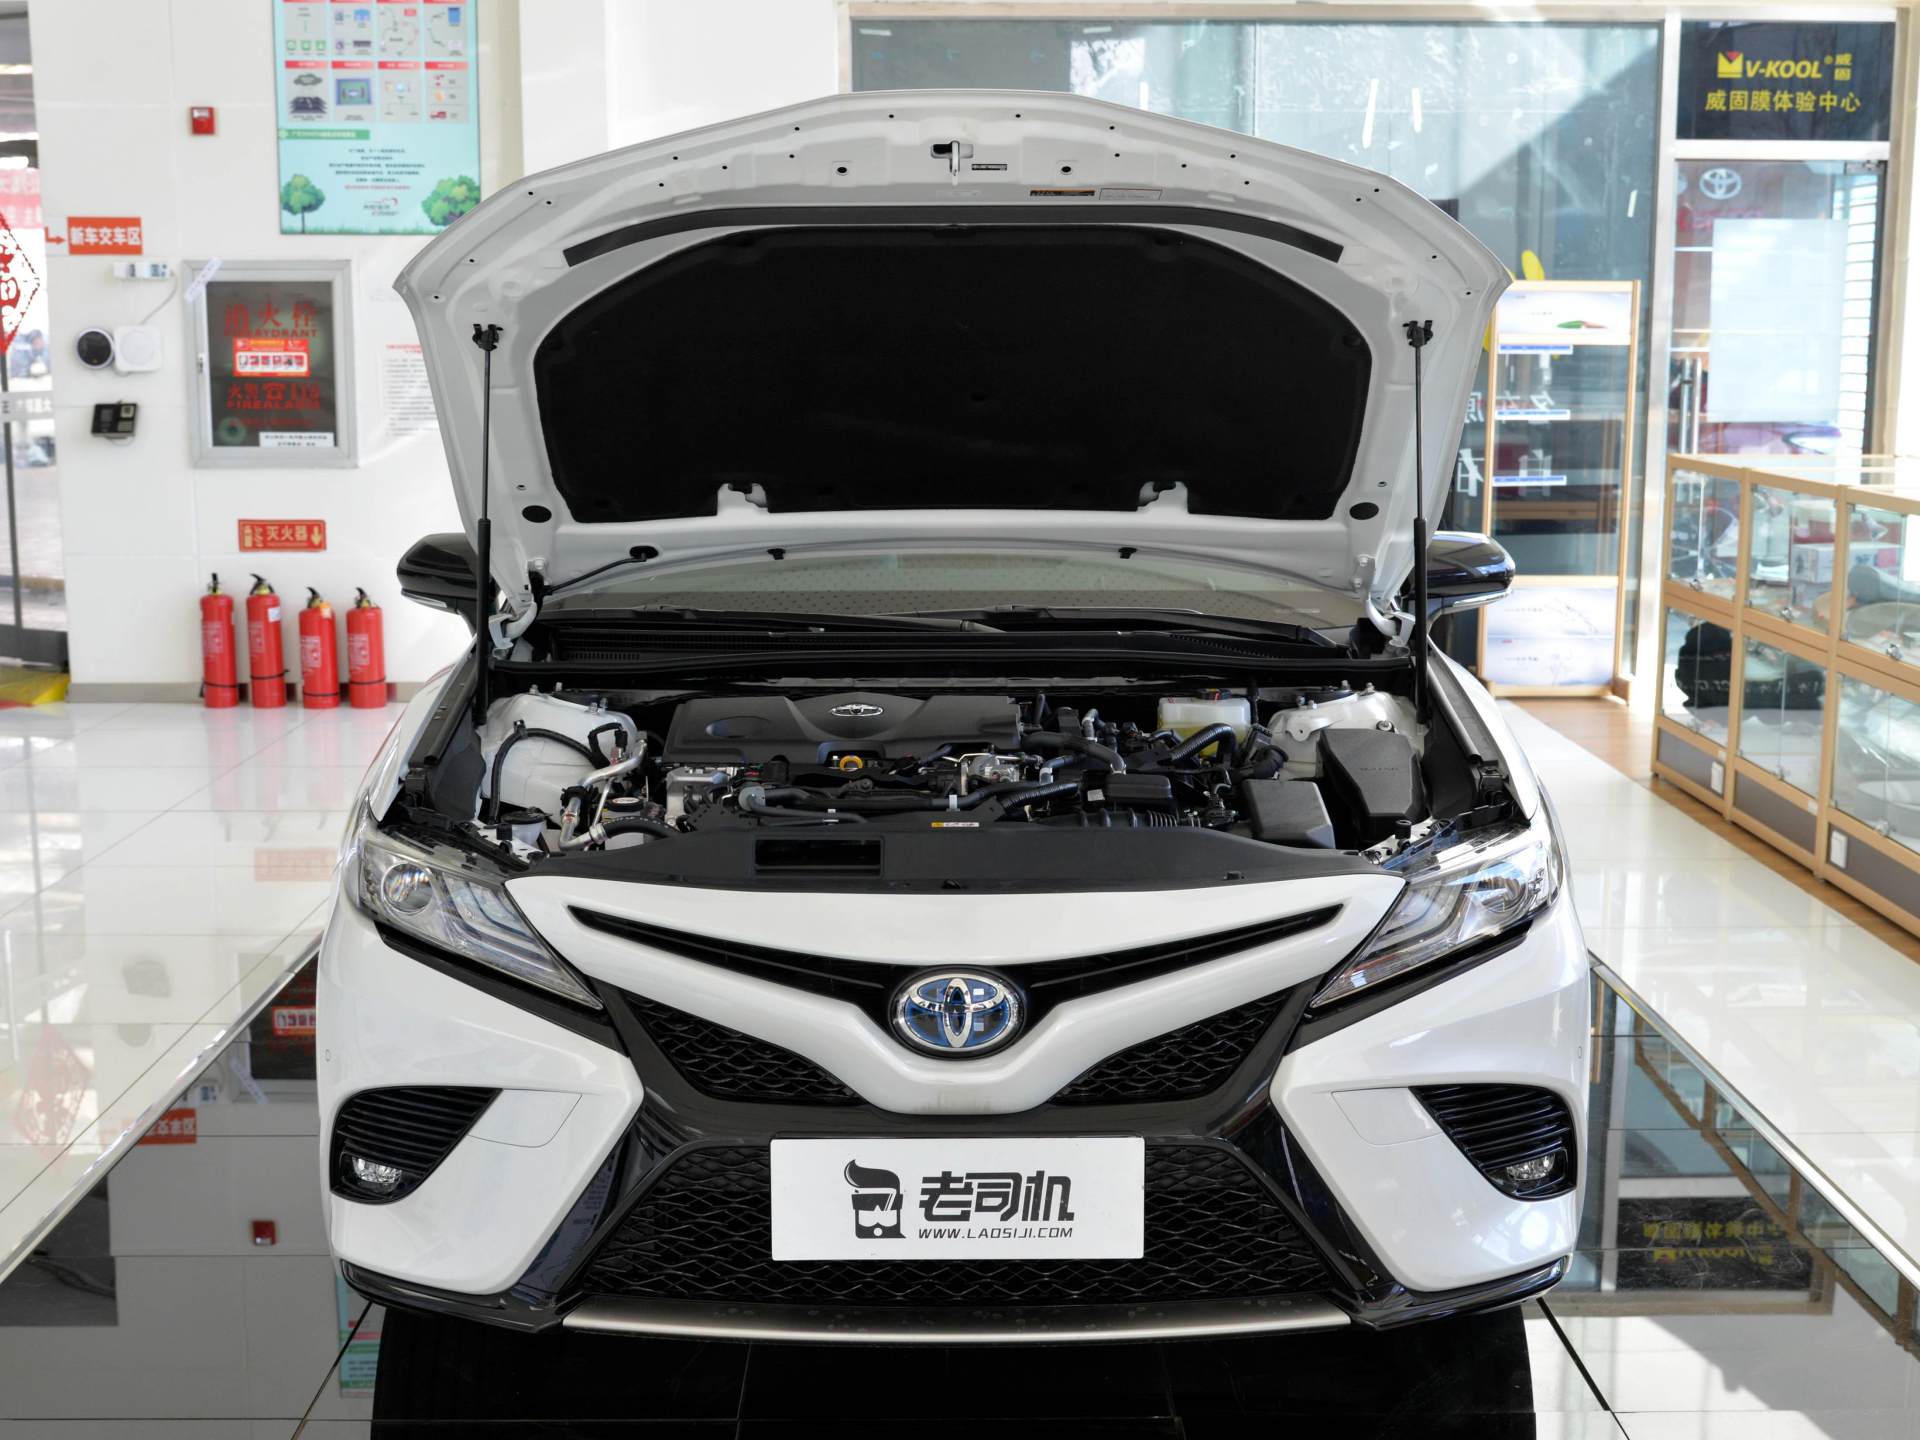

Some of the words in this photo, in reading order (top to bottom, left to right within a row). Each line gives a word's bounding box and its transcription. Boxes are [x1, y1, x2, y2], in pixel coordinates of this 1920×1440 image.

[1705, 89, 1861, 112] 威固膜体验中心
[70, 226, 141, 246] 新车交车区
[267, 525, 308, 541] 灭火器
[919, 1170, 1074, 1222] 老司机
[918, 1227, 1073, 1239] WWW.LAOSIJI.COM
